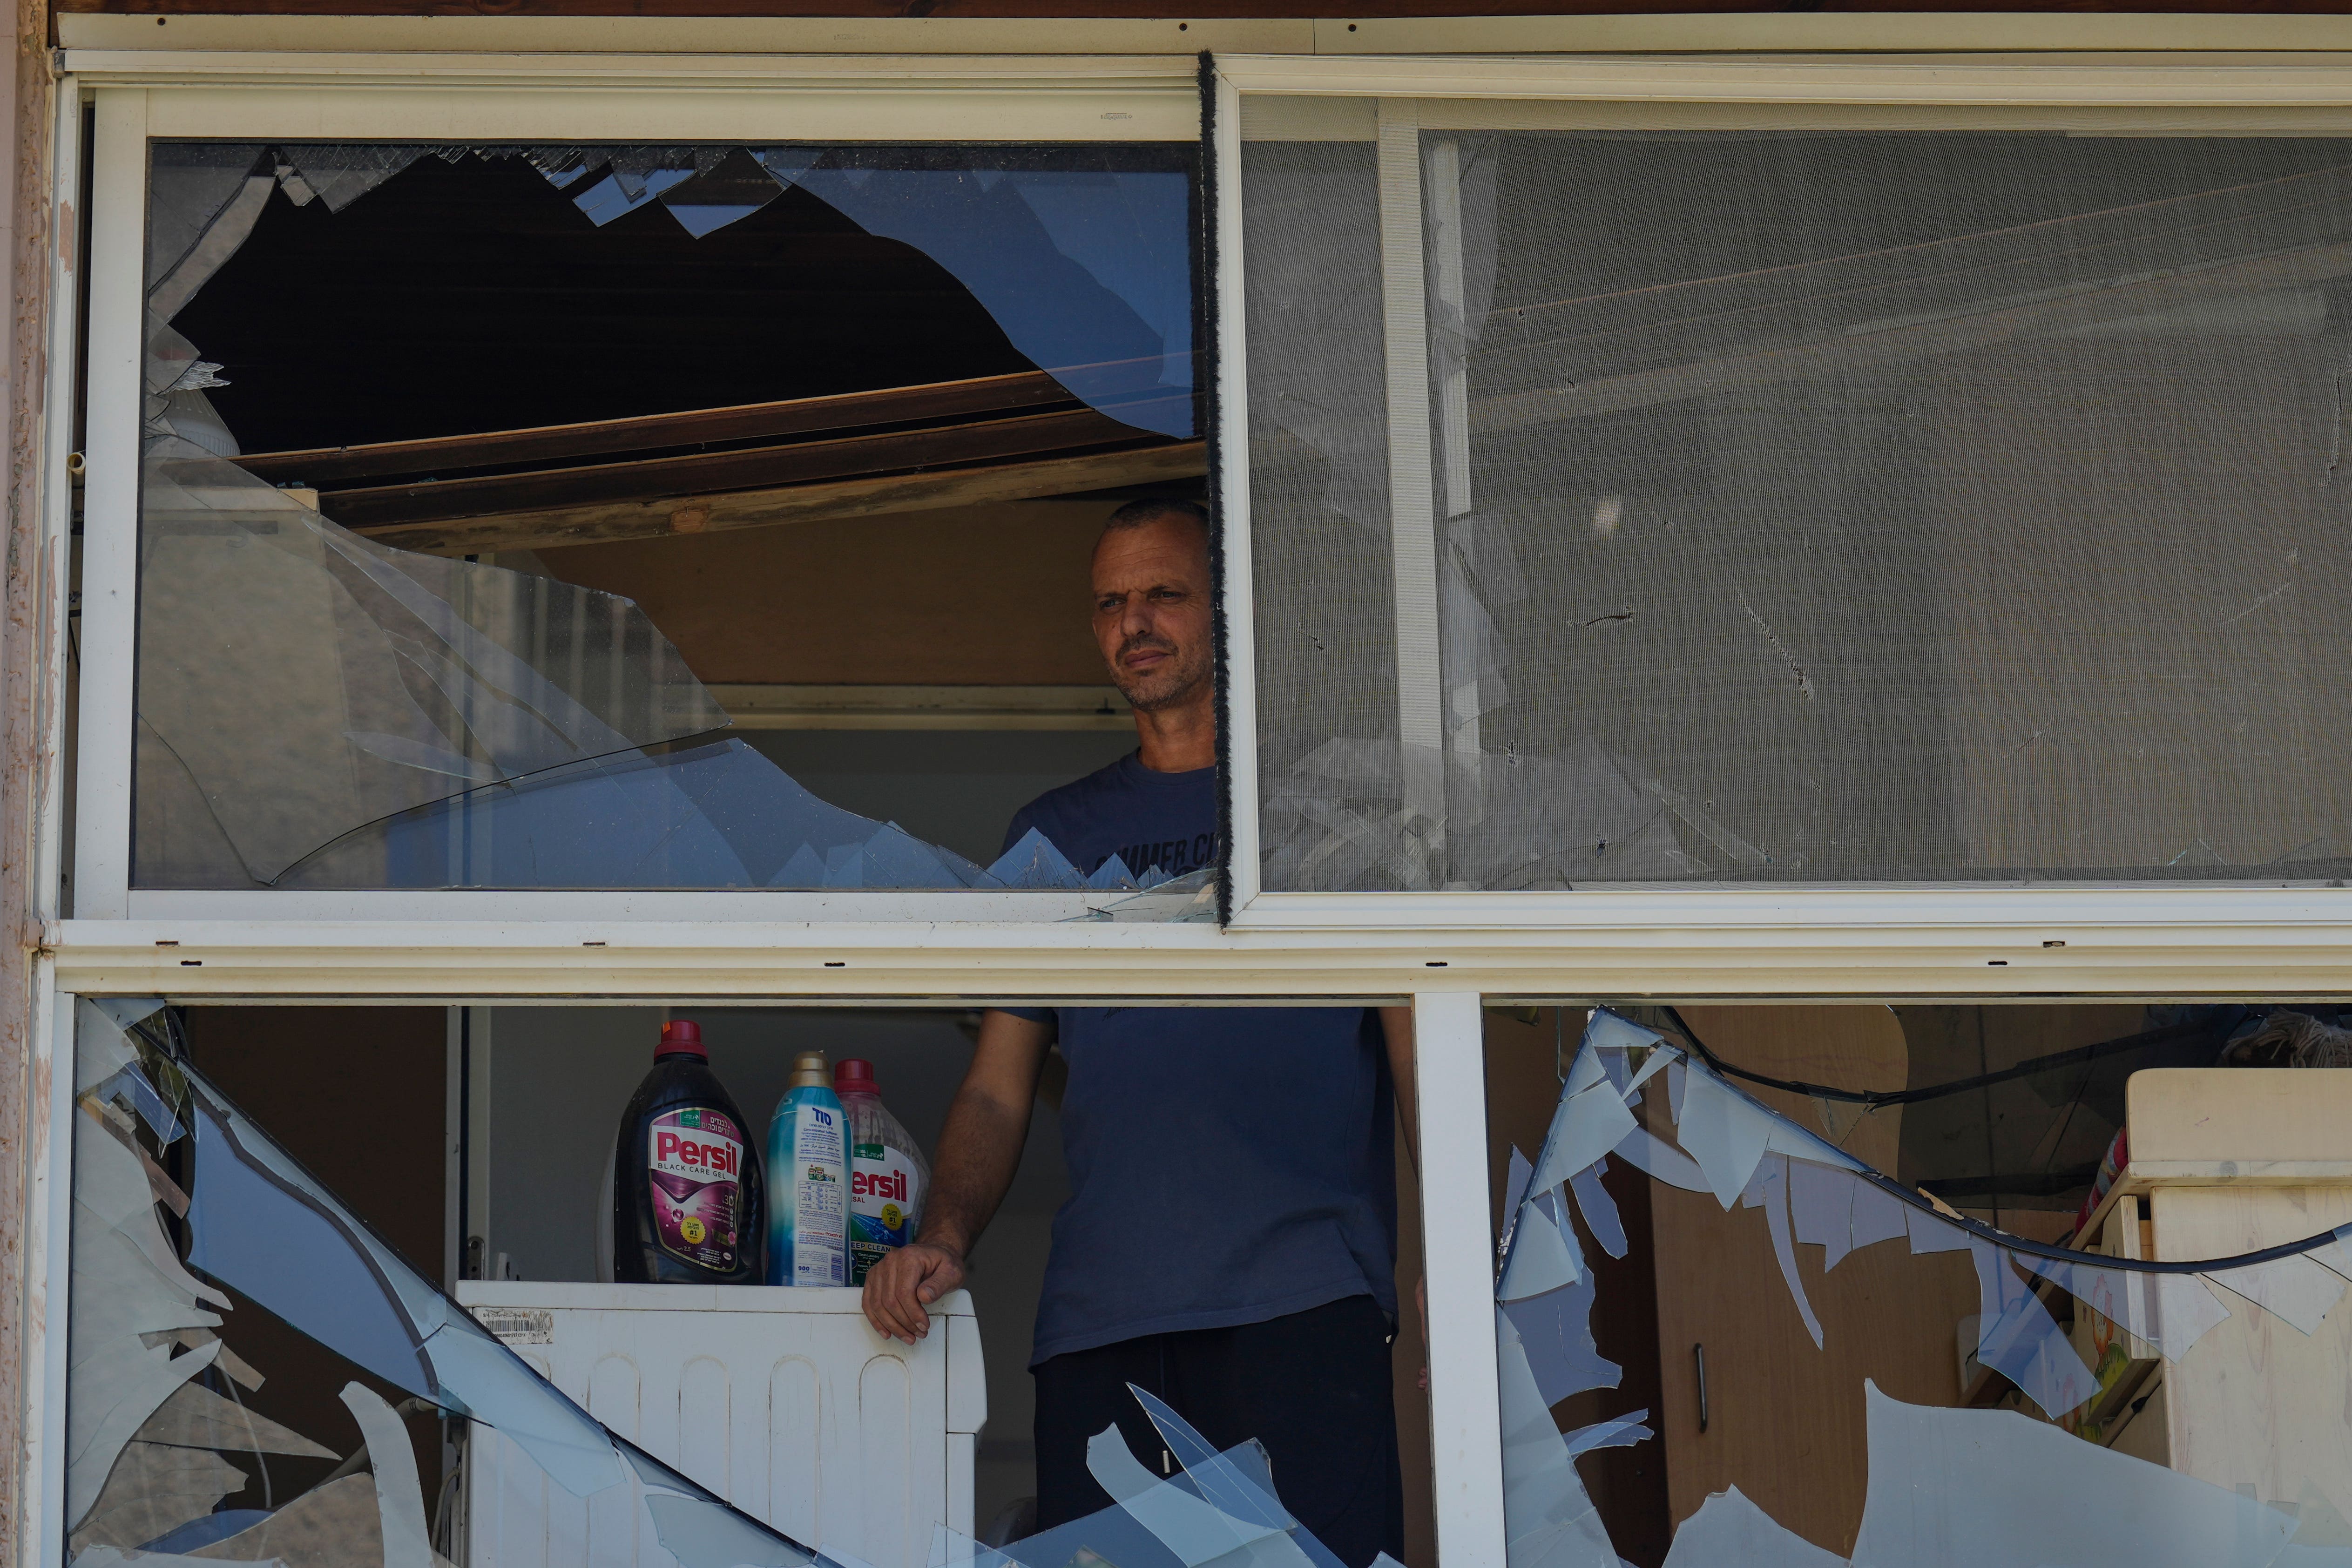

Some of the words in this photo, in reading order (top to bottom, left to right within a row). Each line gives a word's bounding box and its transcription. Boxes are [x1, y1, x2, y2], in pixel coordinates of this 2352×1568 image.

[1095, 839, 1187, 879] MMER
[657, 1132, 737, 1176] Persil
[689, 1166, 710, 1175] CARE
[852, 1169, 907, 1203] ersil
[867, 1244, 891, 1252] CLEAN
